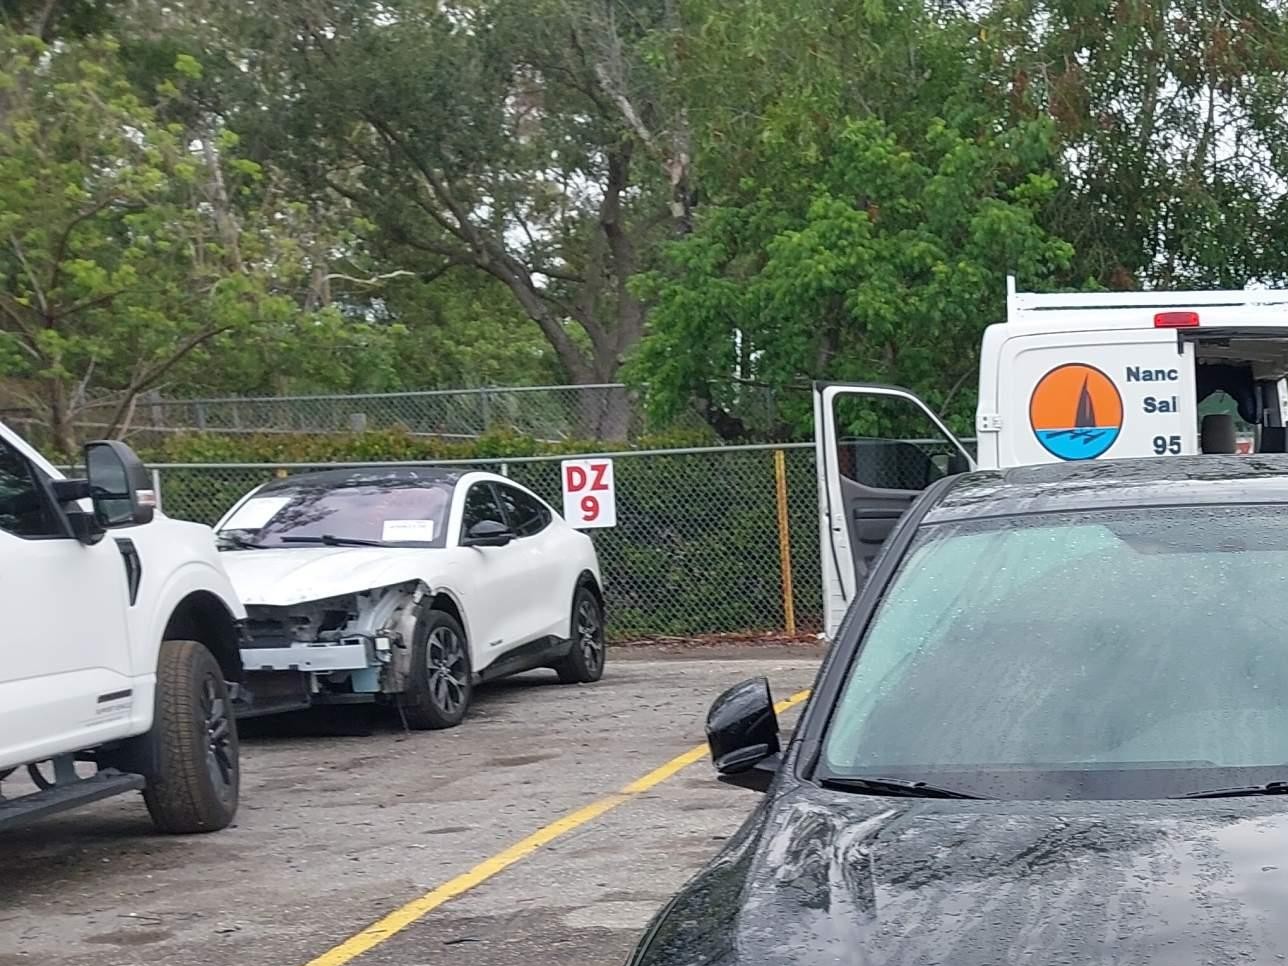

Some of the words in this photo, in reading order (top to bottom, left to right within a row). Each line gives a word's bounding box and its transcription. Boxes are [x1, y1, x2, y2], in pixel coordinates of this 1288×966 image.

[1127, 367, 1177, 382] Nanc
[1153, 436, 1181, 455] 95
[566, 464, 609, 492] DZ
[581, 495, 599, 522] 9
